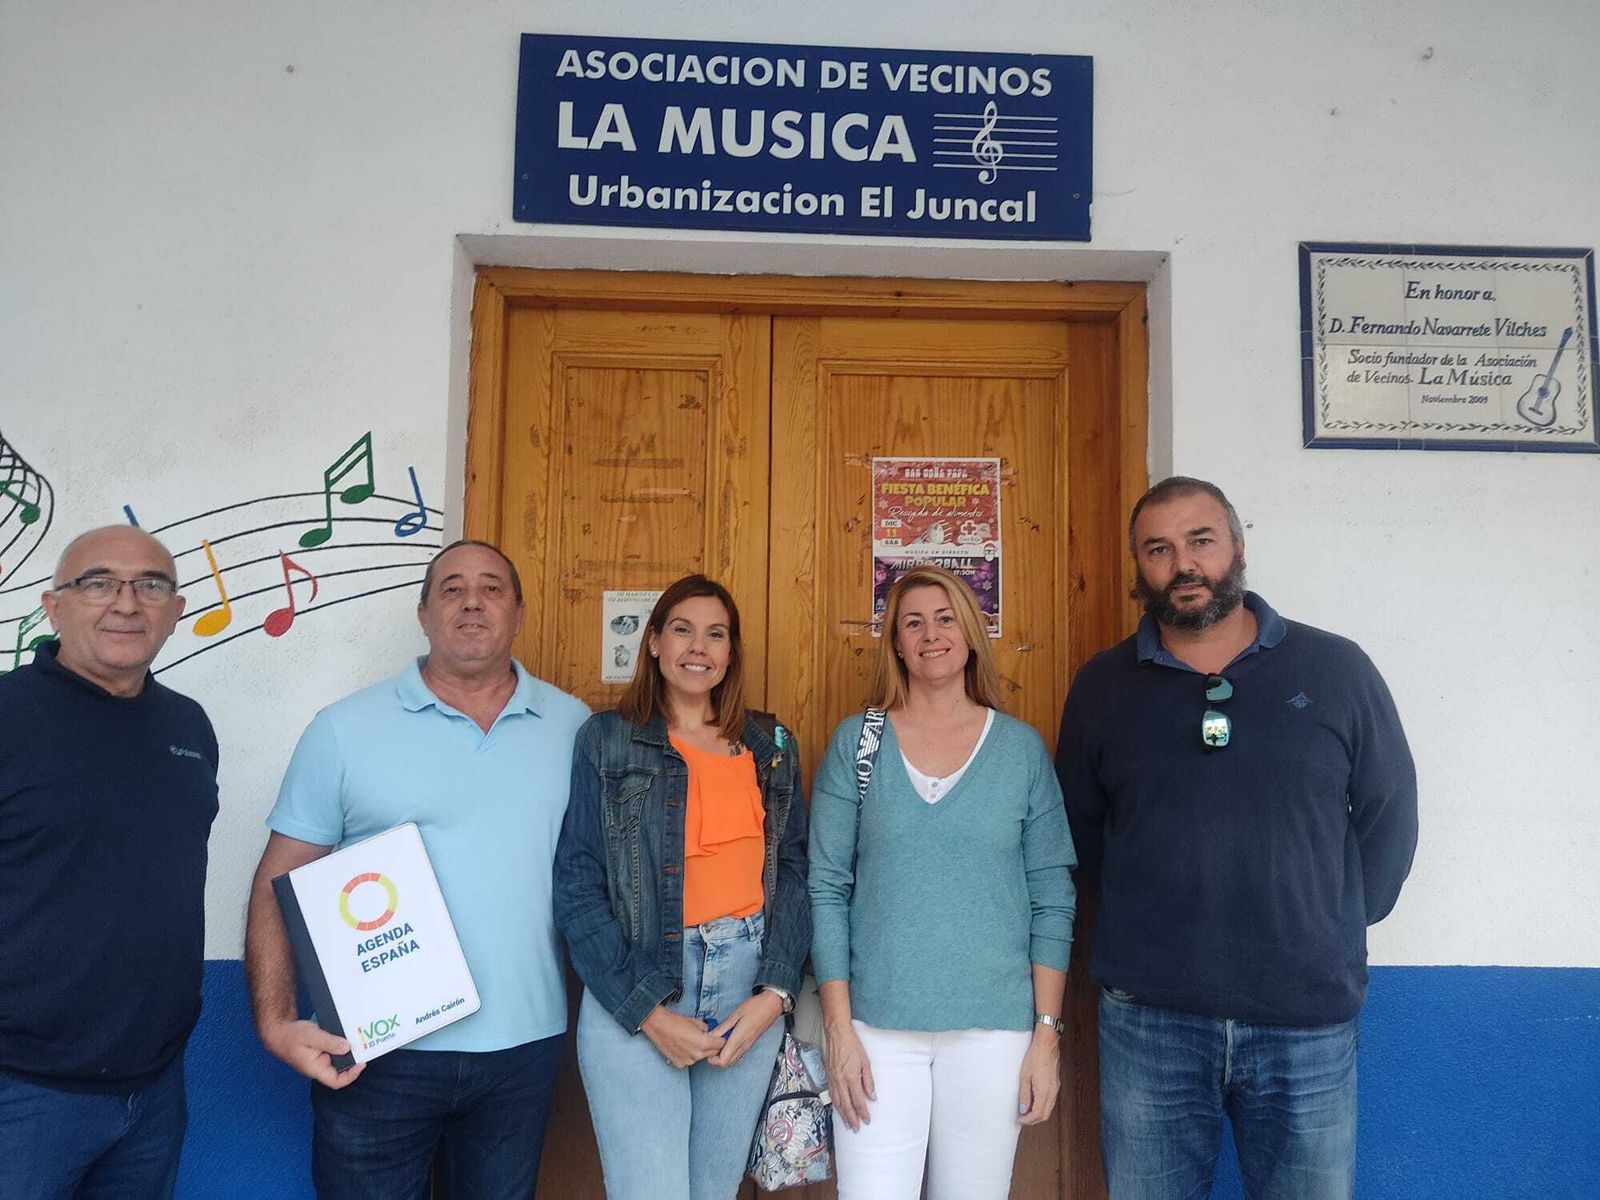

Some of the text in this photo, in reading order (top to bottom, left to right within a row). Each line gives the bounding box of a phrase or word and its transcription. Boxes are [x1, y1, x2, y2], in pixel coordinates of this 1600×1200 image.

[556, 50, 1053, 97] ASOCIACION DE VECINOS
[558, 100, 916, 163] LA MUSICA
[568, 174, 1037, 223] Urbanizacion El Juncal
[1405, 281, 1430, 300] En
[1435, 284, 1479, 301] honor
[1329, 316, 1547, 338] D. Fernando Navarrete Vilches
[1348, 349, 1537, 368] Socio fundador de la Asociación
[1347, 370, 1361, 383] de
[1417, 368, 1444, 385] La
[1446, 368, 1512, 386] Música
[1421, 394, 1466, 404] Noviembre
[881, 481, 990, 495] FIESTA BENÉFICA
[904, 496, 966, 507] POPULAR
[932, 508, 943, 517] de
[885, 529, 897, 537] 11
[356, 922, 414, 957] AGENDA
[361, 940, 420, 973] ESPAÑA
[415, 996, 465, 1025] Andrés Cairón
[363, 1014, 400, 1038] VOX
